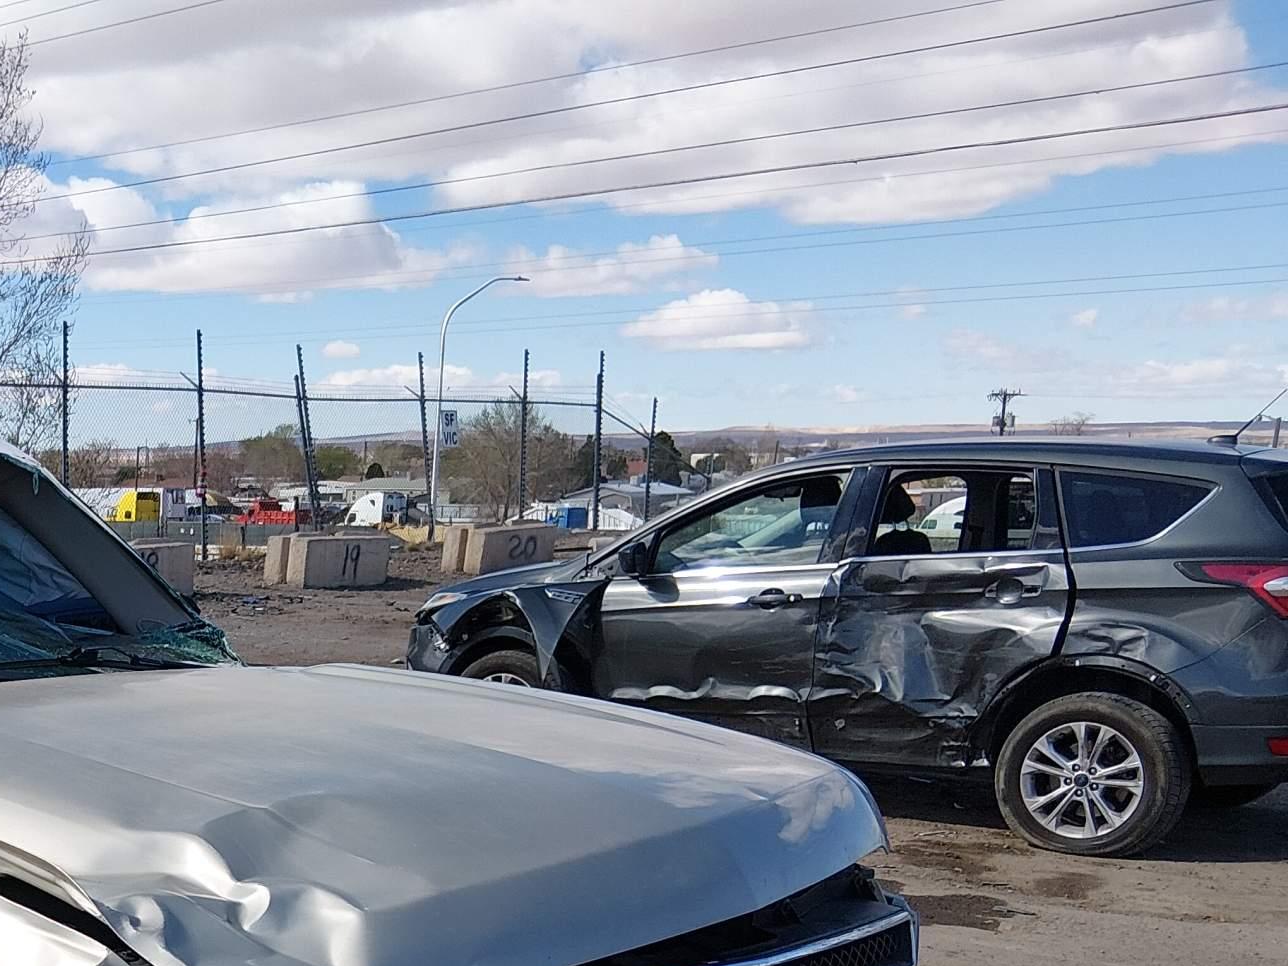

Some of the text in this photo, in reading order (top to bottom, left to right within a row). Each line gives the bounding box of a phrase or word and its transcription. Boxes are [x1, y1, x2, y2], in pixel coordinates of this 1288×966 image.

[444, 413, 455, 427] SF
[443, 431, 458, 446] VIC
[508, 534, 538, 560] 20
[342, 544, 361, 583] 19
